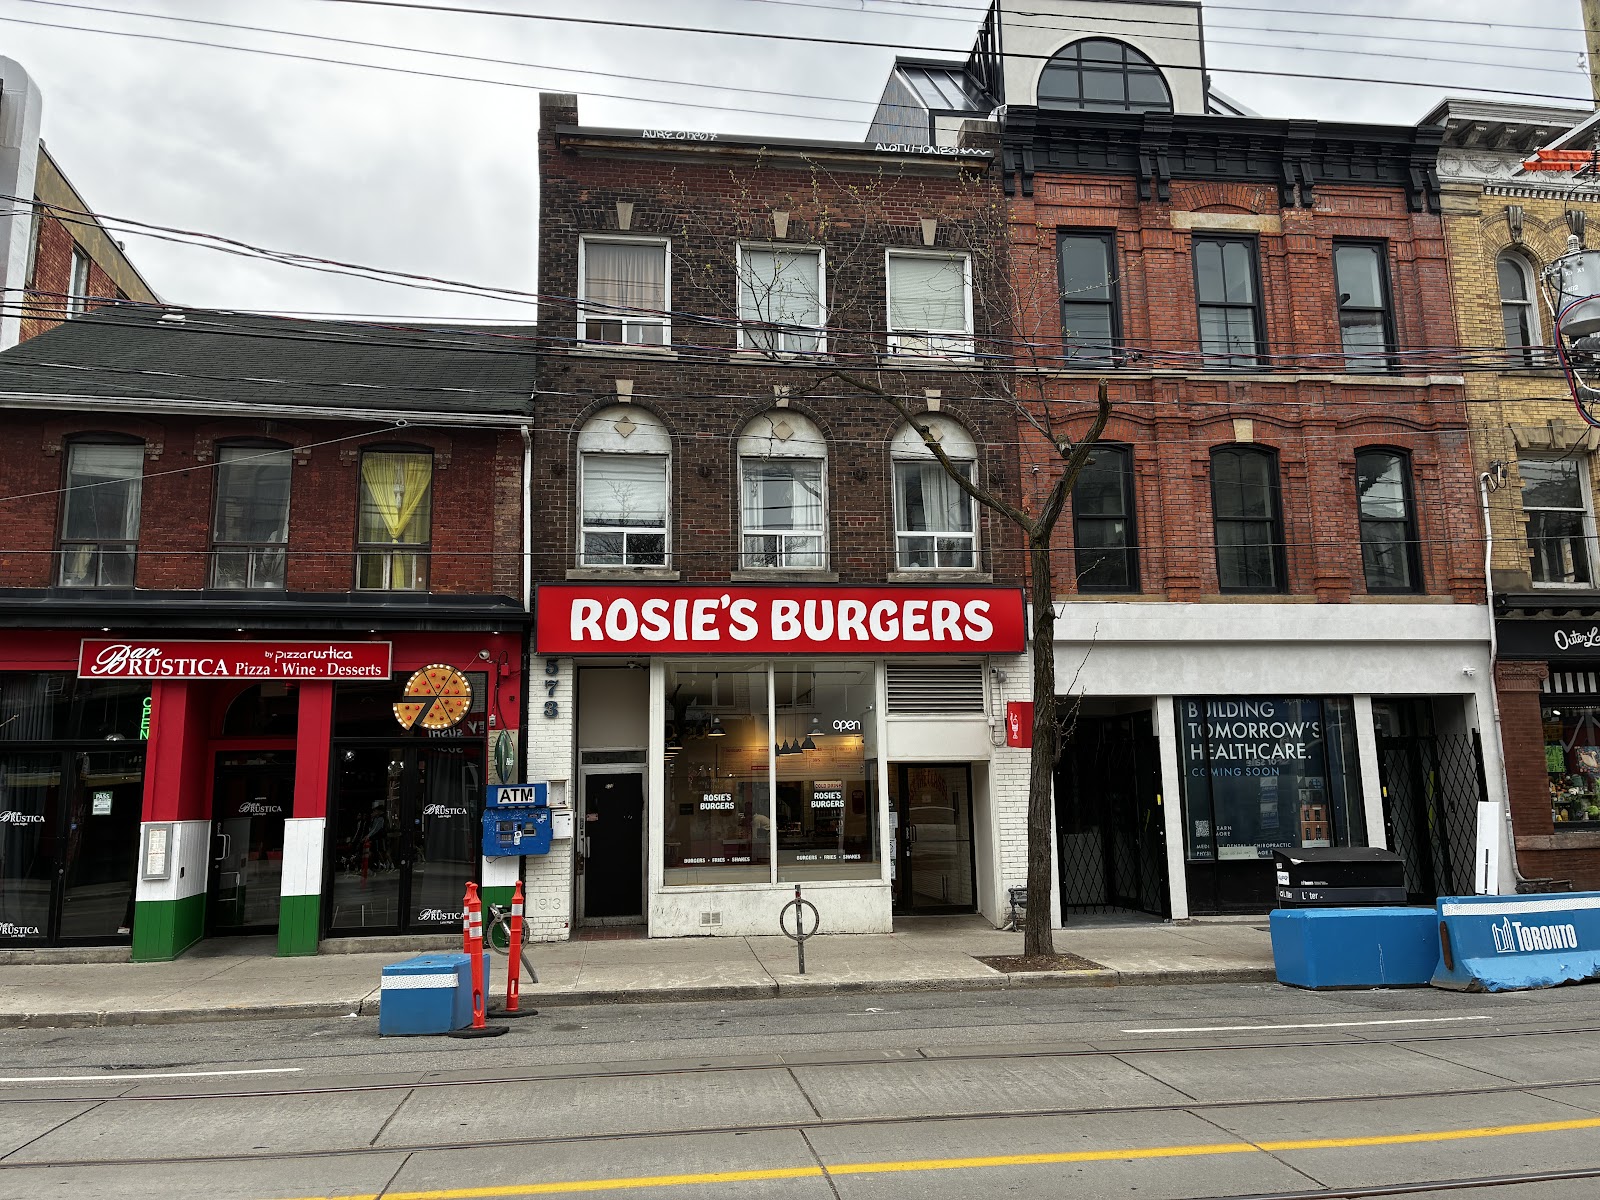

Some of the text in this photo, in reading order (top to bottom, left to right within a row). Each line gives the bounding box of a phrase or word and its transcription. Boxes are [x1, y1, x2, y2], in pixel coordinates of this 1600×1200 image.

[570, 594, 994, 642] ROSIE'S BURGERS
[1554, 630, 1588, 650] Outer
[91, 644, 162, 675] Bar
[264, 651, 274, 659] by
[127, 659, 229, 676] RUSTICA
[235, 662, 382, 676] Pizza Wine Desserts
[543, 658, 559, 719] 573
[833, 719, 861, 732] open
[1188, 722, 1320, 738] TOMORROW'S
[1190, 743, 1312, 760] HEALTHCARE.
[1245, 767, 1279, 777] SOON
[500, 788, 533, 803] ATM
[703, 793, 731, 802] ROSIE'S
[814, 791, 841, 800] ROSIE'S
[250, 805, 282, 813] RUSTICA
[700, 802, 735, 810] BURGERS
[811, 800, 845, 808] BURGERS
[434, 807, 467, 815] RUSTICA
[10, 814, 46, 823] RUSTICA
[430, 911, 465, 921] RUSTICA
[2, 926, 40, 935] RUSTICA
[1511, 921, 1578, 952] TORONTO
